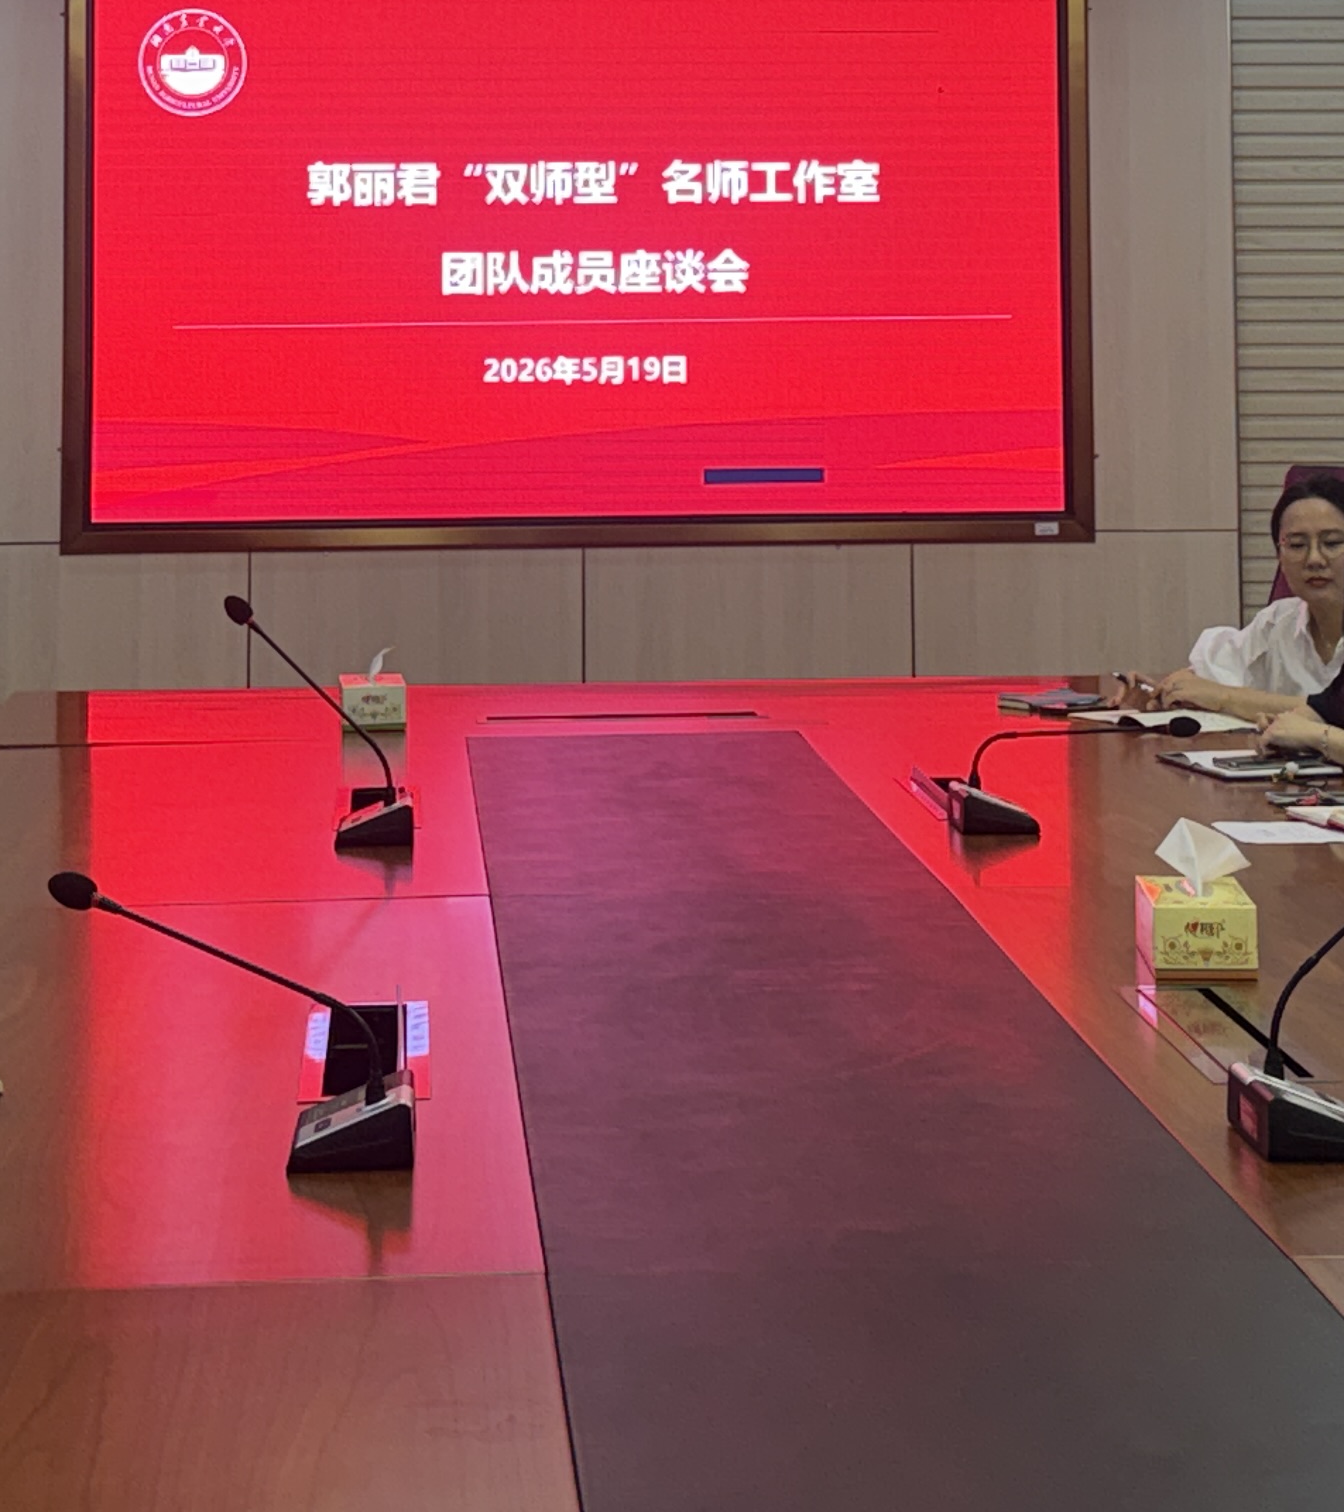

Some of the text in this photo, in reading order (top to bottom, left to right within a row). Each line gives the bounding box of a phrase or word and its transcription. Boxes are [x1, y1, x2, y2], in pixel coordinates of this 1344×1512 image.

[441, 248, 750, 297] 团队成员座谈会
[483, 355, 688, 387] 2026年5月19日
